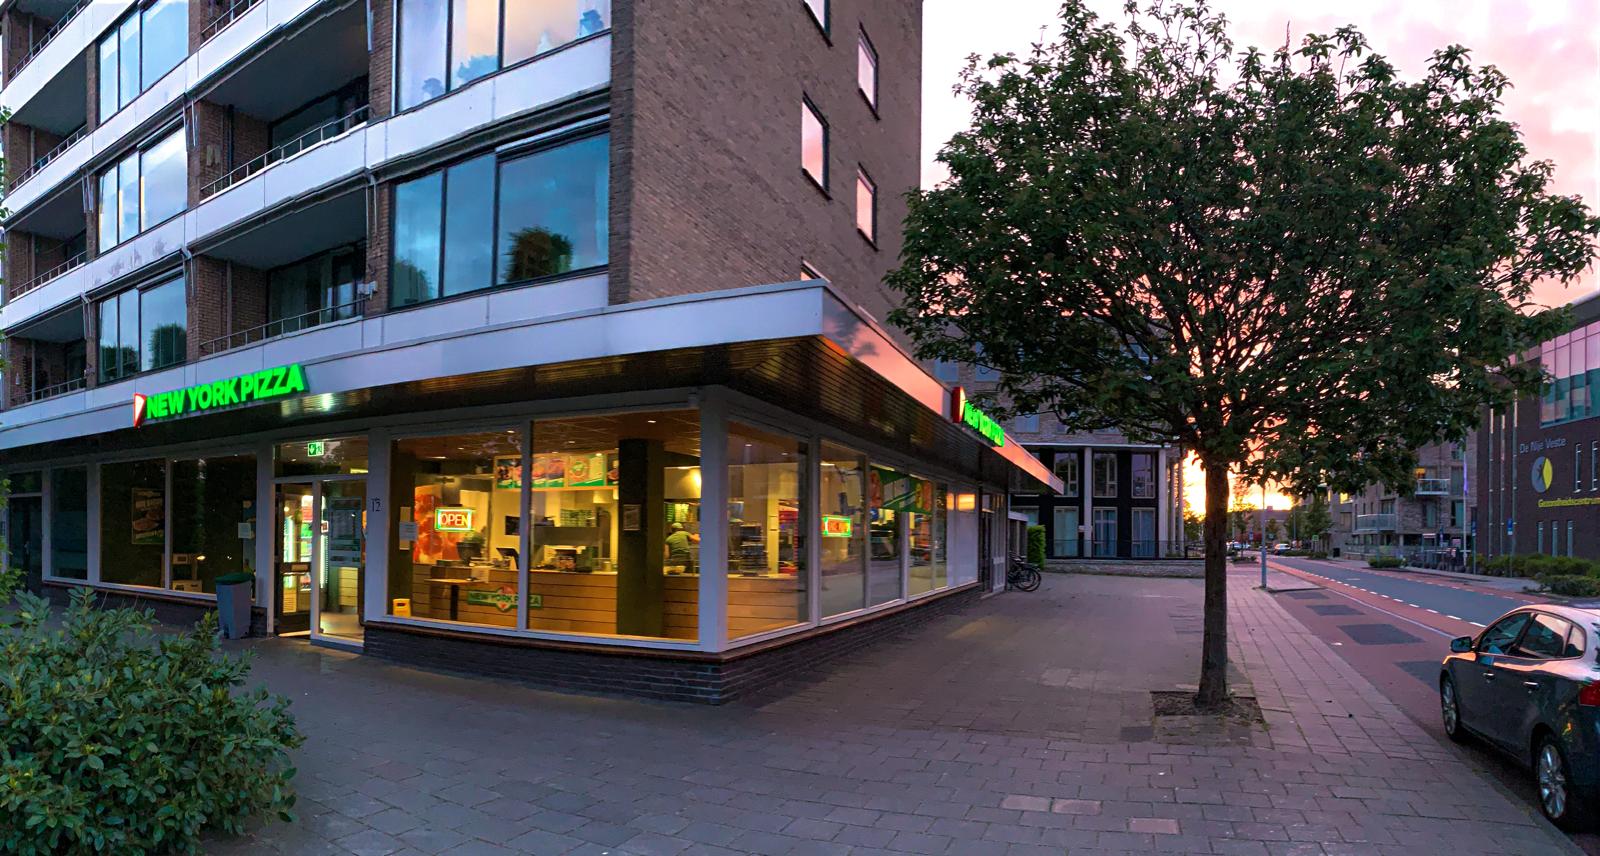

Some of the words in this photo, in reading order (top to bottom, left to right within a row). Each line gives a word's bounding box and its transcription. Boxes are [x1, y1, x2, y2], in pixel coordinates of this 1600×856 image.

[146, 389, 186, 419] NEW
[187, 376, 238, 411] YORK
[240, 363, 306, 401] PIZZA
[440, 513, 469, 526] OPEN
